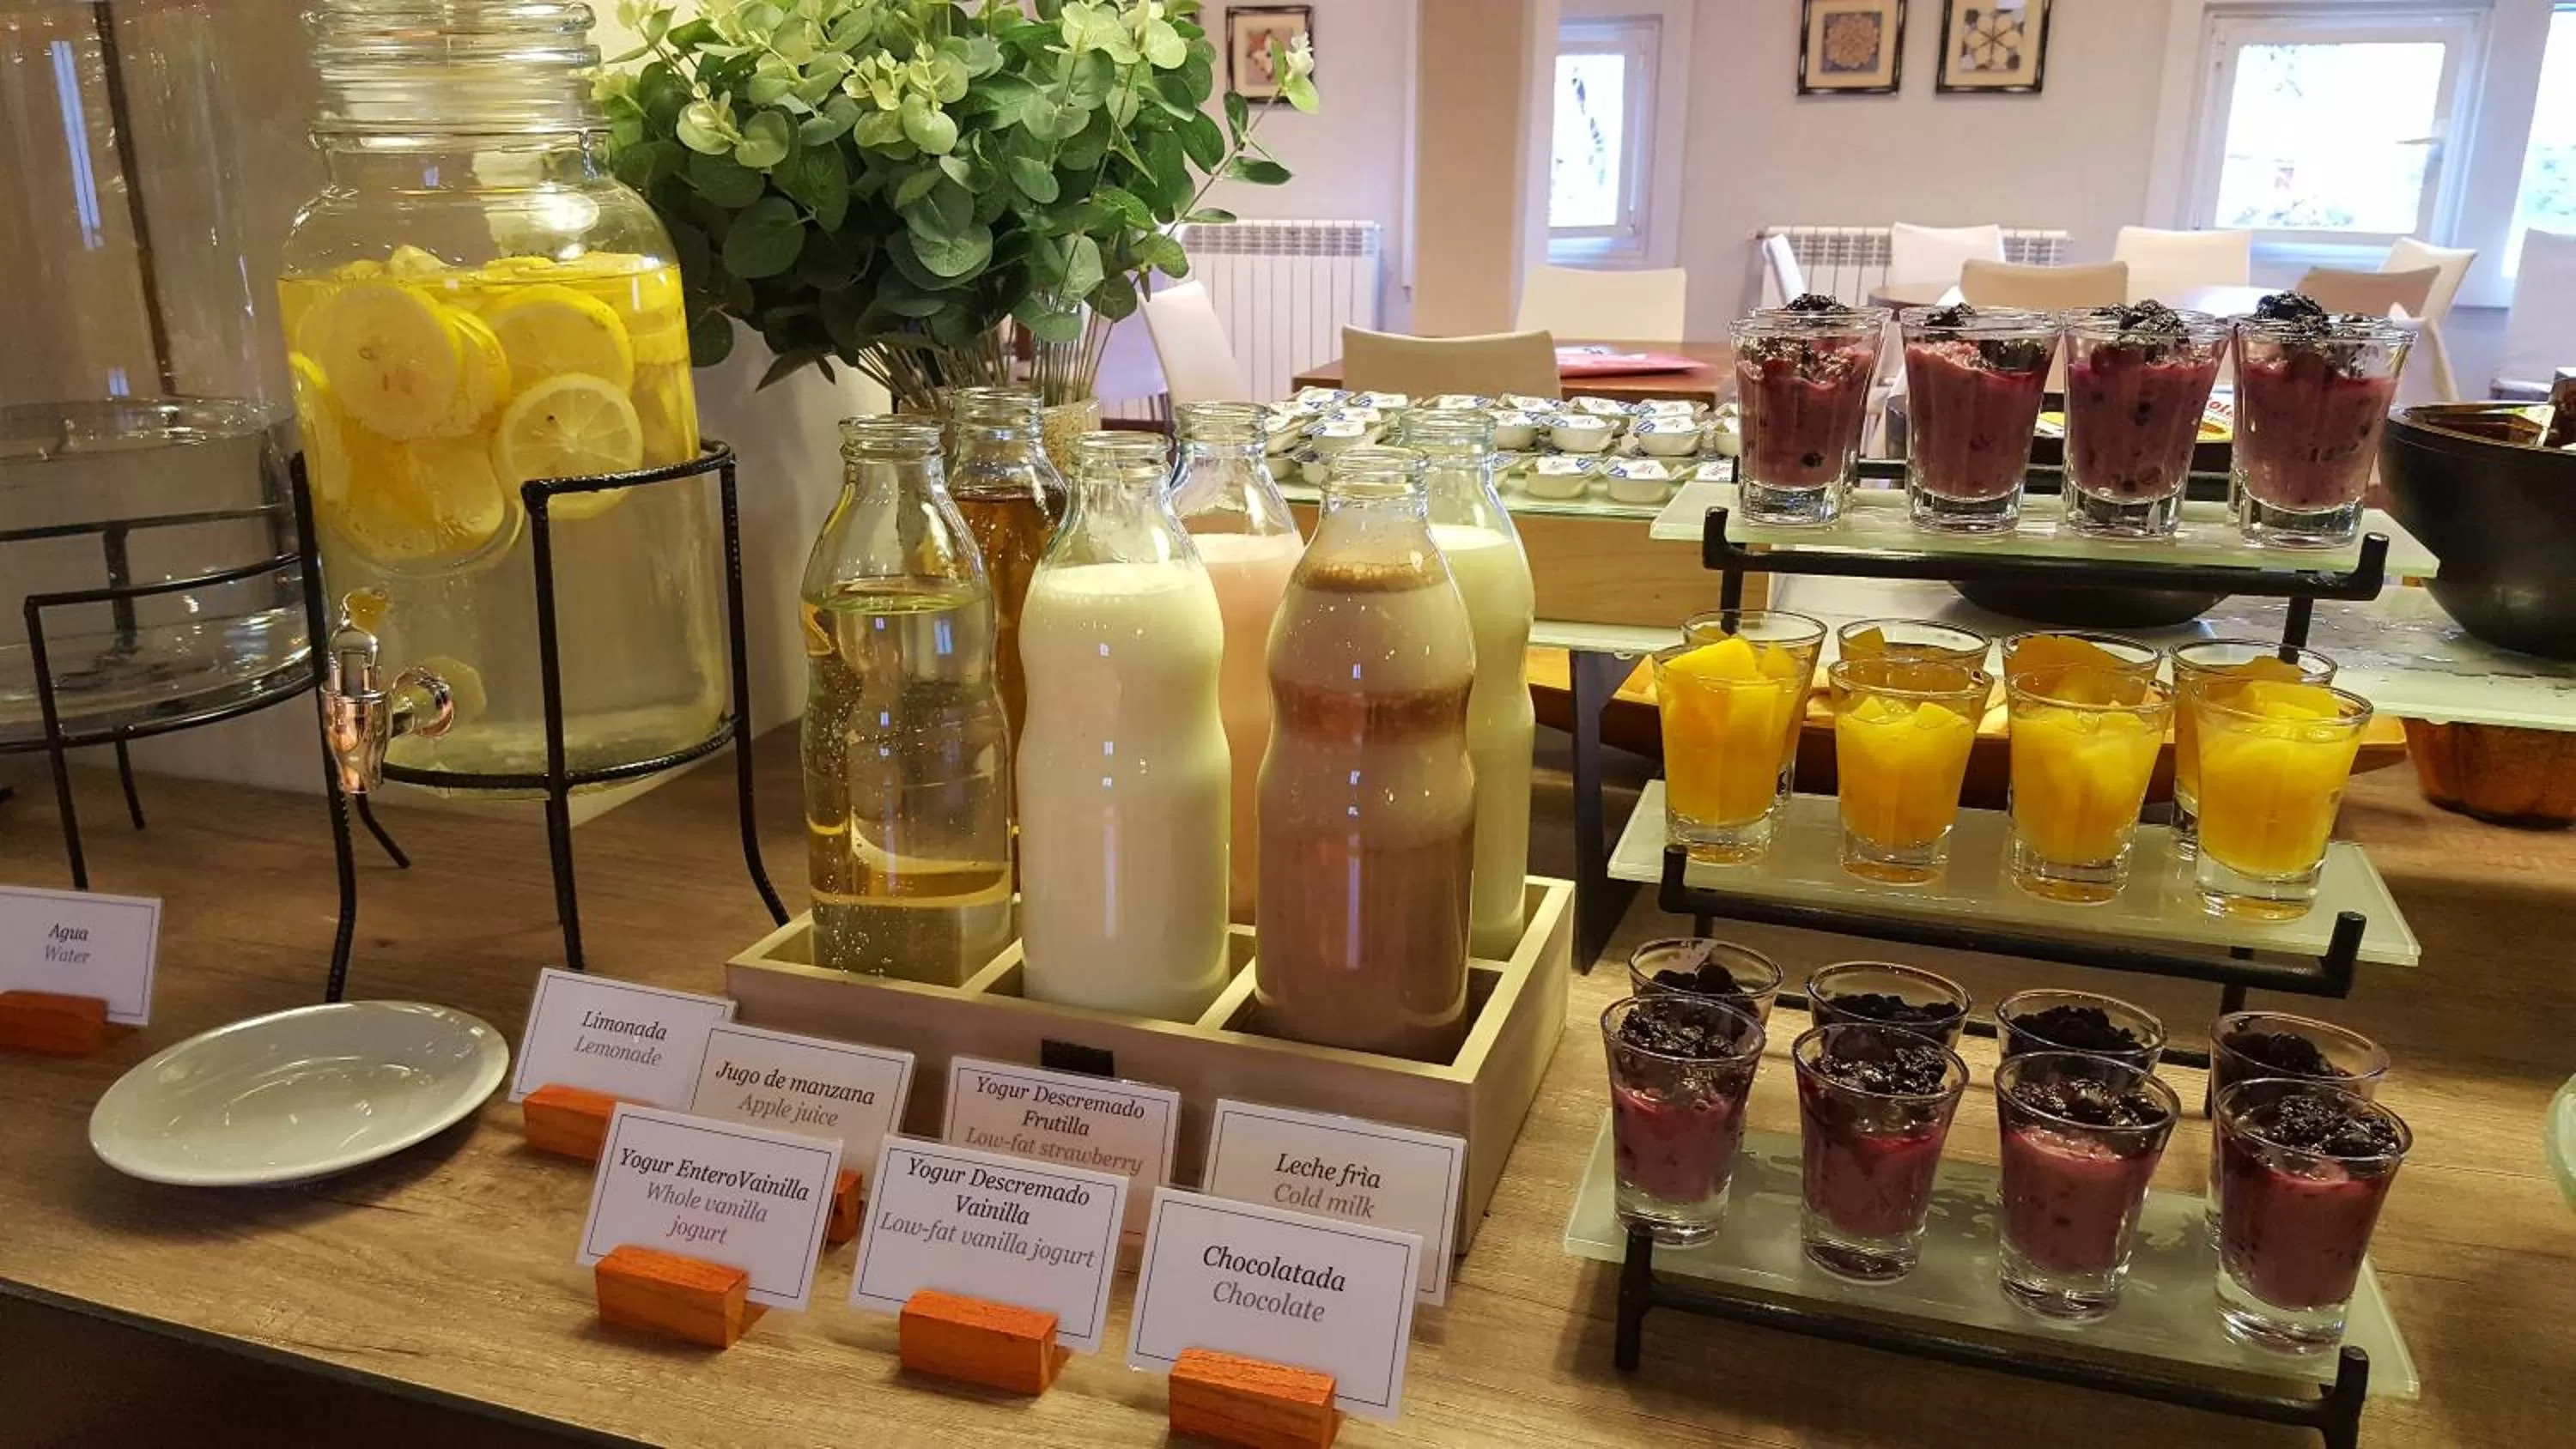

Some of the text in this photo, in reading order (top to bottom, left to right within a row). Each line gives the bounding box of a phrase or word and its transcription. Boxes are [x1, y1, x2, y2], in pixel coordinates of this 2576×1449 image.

[48, 923, 88, 943] Agua
[44, 945, 91, 964] Water
[581, 1010, 667, 1041] Limonada
[574, 1036, 663, 1067] Lemonade
[715, 1060, 875, 1106] Jugo de manzana
[975, 1076, 1145, 1119] Yogur Descremado
[738, 1092, 839, 1127] Apple juice
[1022, 1110, 1090, 1138] Frutilla
[620, 1147, 673, 1175] Yogur
[964, 1125, 1144, 1175] Low-fat strawberry
[1275, 1153, 1335, 1182] Leche
[906, 1157, 1091, 1206] Yogur Descremado
[647, 1180, 768, 1223] Whole vanilla
[956, 1194, 1030, 1225] Vainilla
[1273, 1183, 1376, 1219] Cold milk
[667, 1215, 729, 1246] jogurt
[880, 1211, 1095, 1269] Low-fat vanilla jogurt
[1202, 1245, 1346, 1292] Chocolatada
[1213, 1281, 1325, 1323] Chocolate
